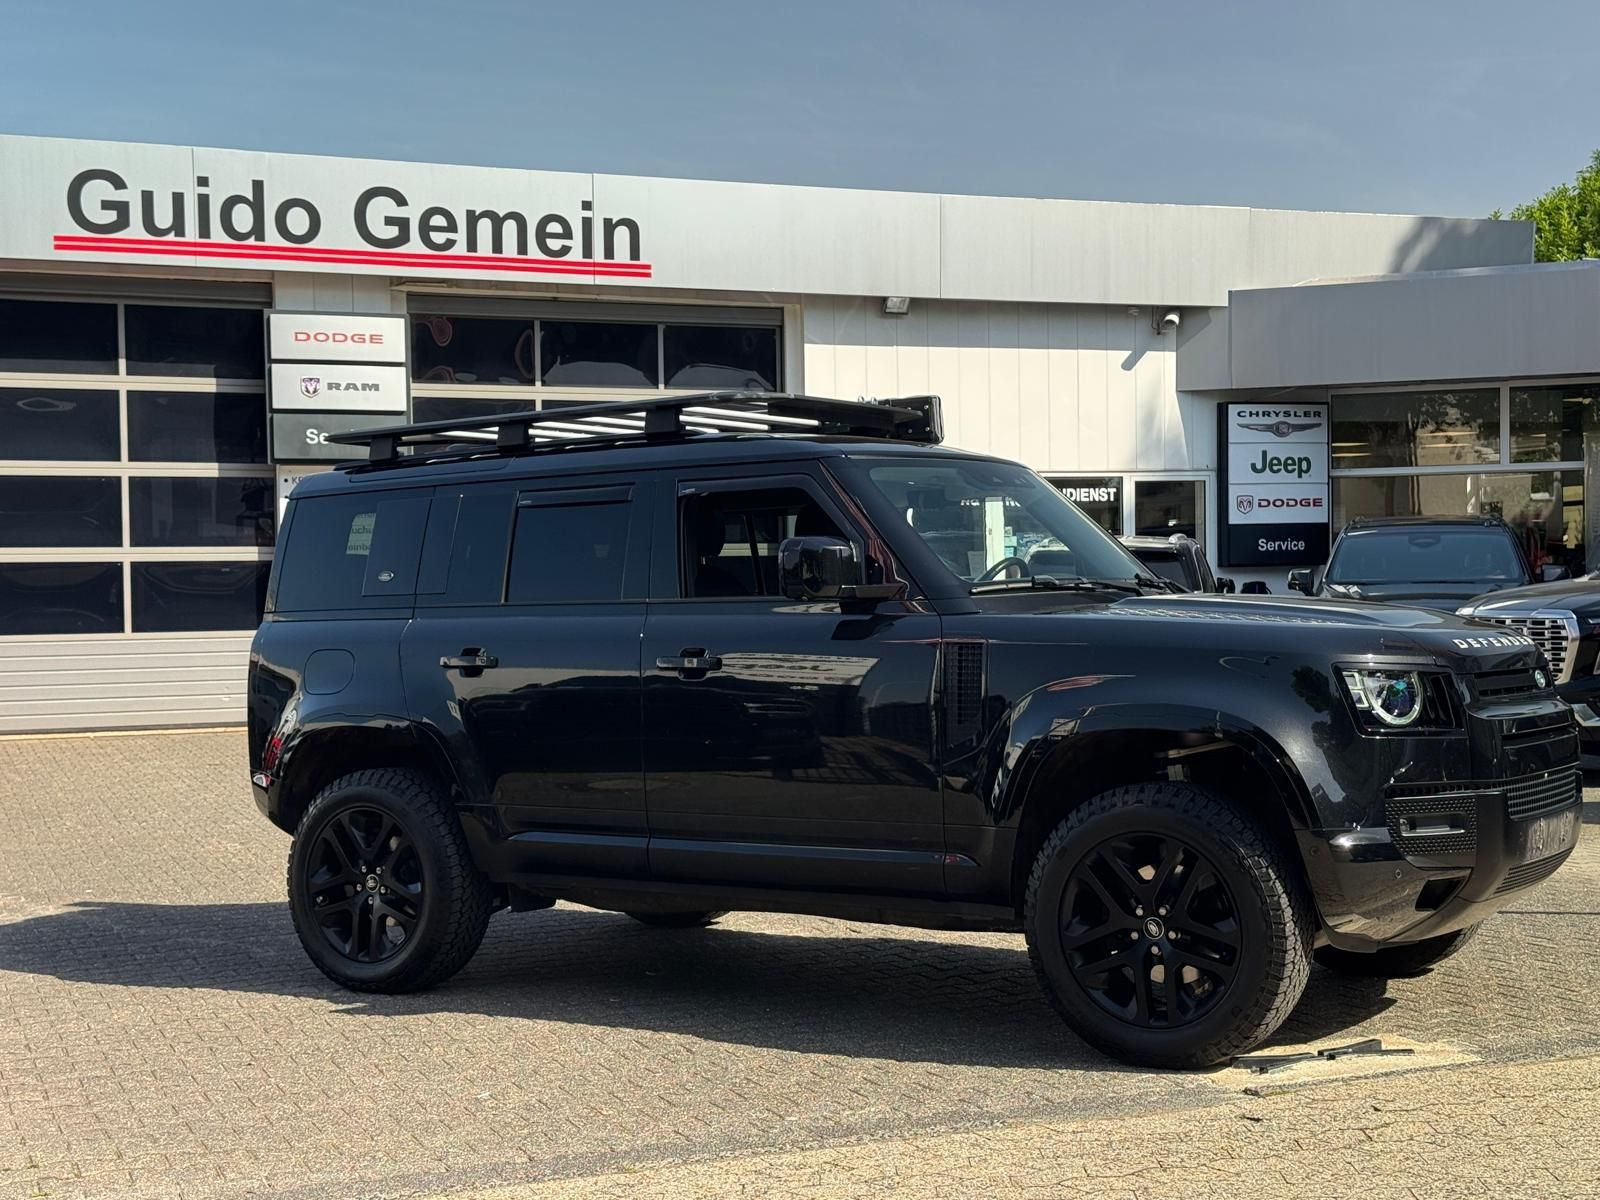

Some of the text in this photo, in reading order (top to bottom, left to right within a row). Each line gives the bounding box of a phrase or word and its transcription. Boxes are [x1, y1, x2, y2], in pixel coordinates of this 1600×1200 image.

[66, 168, 641, 261] Guido Gemein
[294, 331, 384, 344] DODGE
[326, 382, 380, 391] RAM
[1236, 410, 1322, 418] CHRYSLER
[1250, 449, 1312, 478] Jeep
[1061, 487, 1117, 502] DIENST
[1257, 498, 1323, 508] DODGE
[1258, 538, 1305, 551] Service
